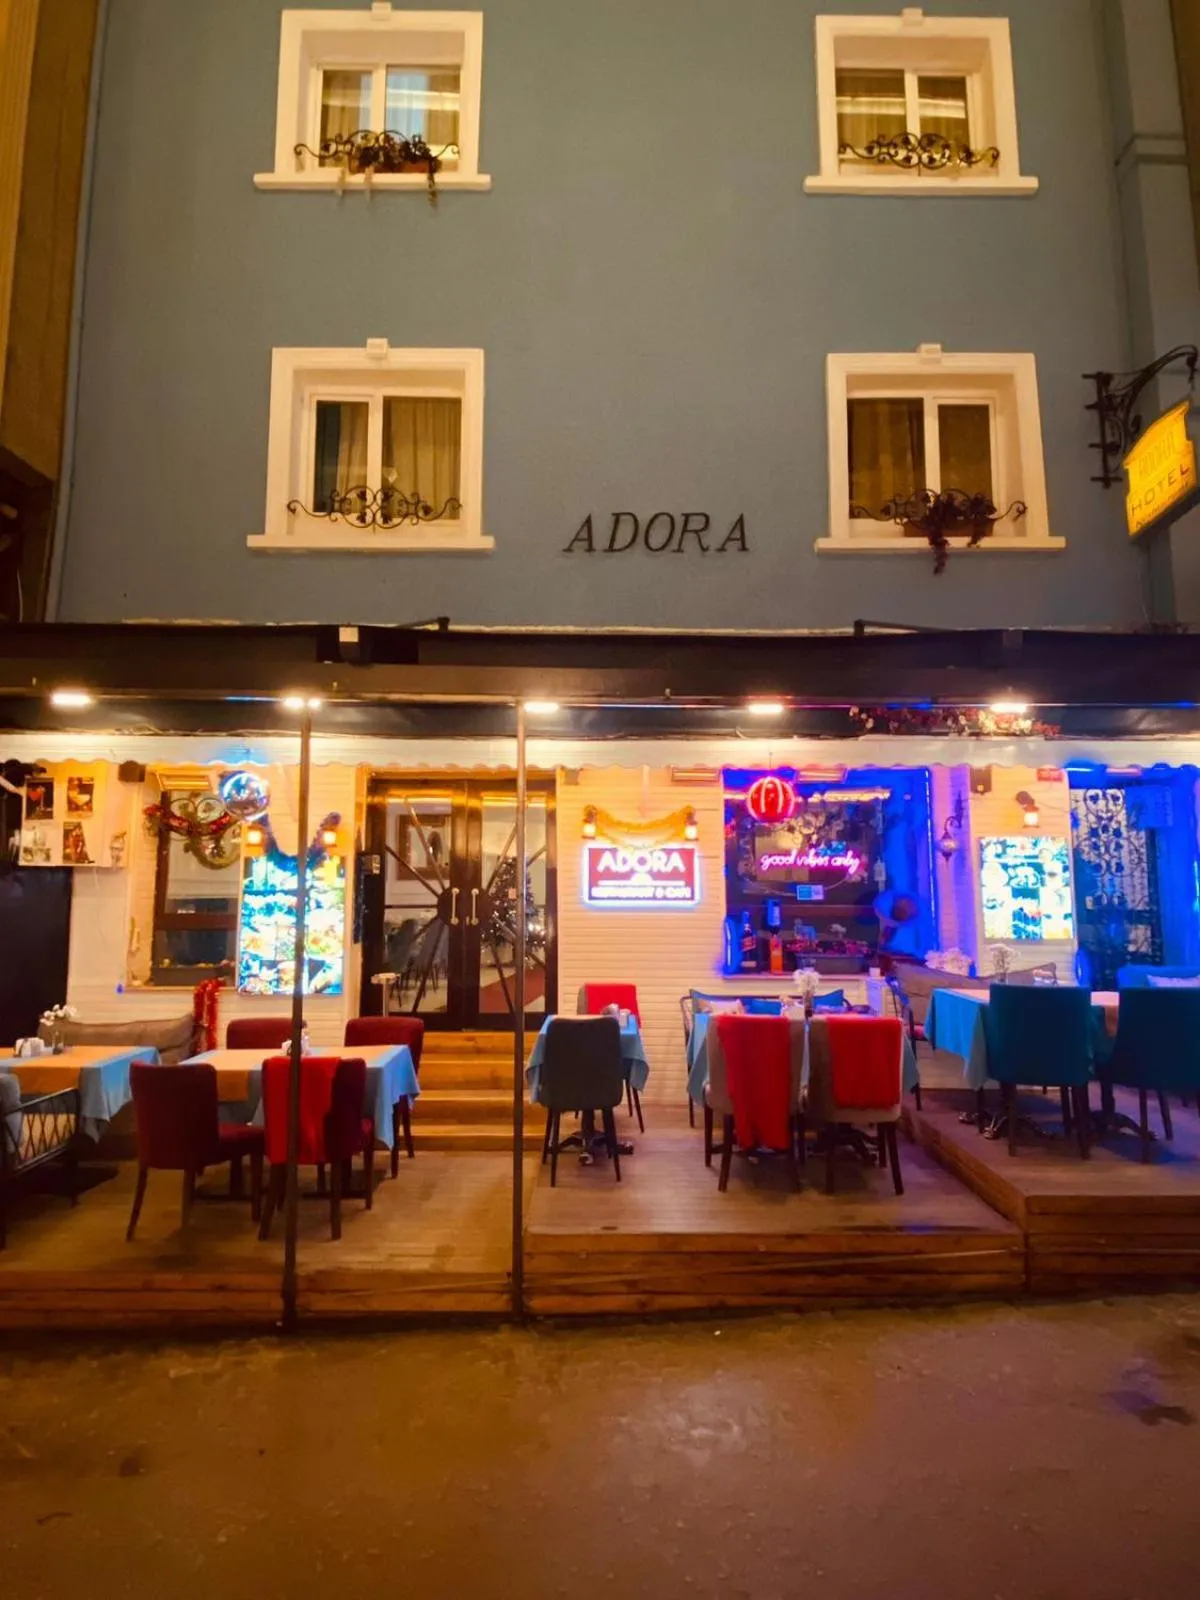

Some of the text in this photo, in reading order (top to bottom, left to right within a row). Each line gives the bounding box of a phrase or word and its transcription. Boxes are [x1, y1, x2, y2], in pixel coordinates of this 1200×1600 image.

[1132, 464, 1190, 516] HOTEL
[562, 512, 749, 552] ADORA
[597, 849, 686, 873] ADORA
[760, 849, 798, 871] good
